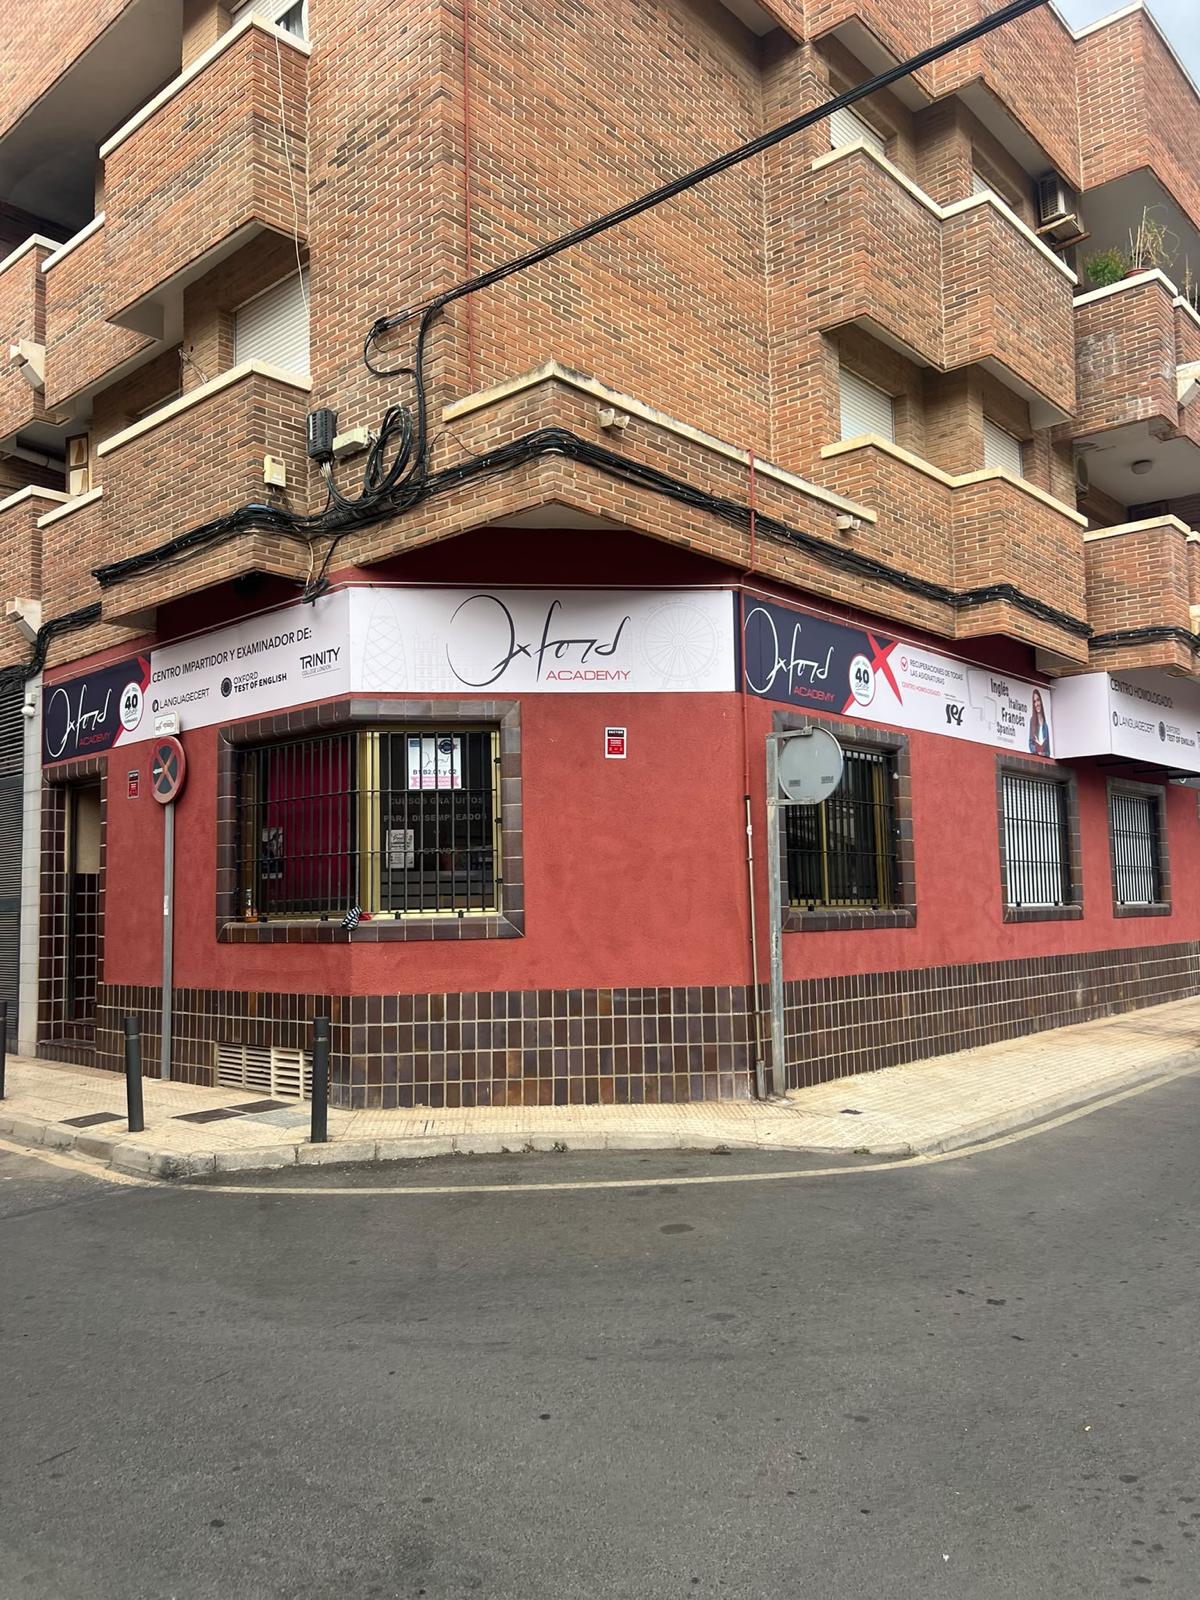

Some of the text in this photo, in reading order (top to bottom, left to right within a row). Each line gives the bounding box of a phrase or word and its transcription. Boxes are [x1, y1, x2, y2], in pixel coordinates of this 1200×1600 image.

[446, 594, 632, 688] Oxford
[152, 627, 312, 683] CENTRO IMPARTIDOR Y EXAMINADOR DE:
[299, 646, 341, 670] TRINITY
[744, 607, 835, 695] Oxford
[233, 671, 259, 685] OXFORD
[234, 672, 287, 693] TEST OF ENGLISH
[545, 669, 632, 682] ACADEMY
[855, 667, 870, 685] 40
[793, 685, 836, 702] ACADEMY
[1110, 678, 1134, 697] CENTRO
[124, 694, 139, 710] 40
[160, 687, 210, 709] LANGUAGECERT
[46, 684, 112, 758] Oxford
[1001, 707, 1026, 727] Francés
[79, 731, 112, 747] ACADEMY
[430, 796, 484, 806] GAUIOS
[411, 813, 487, 823] DSEMPEADO
